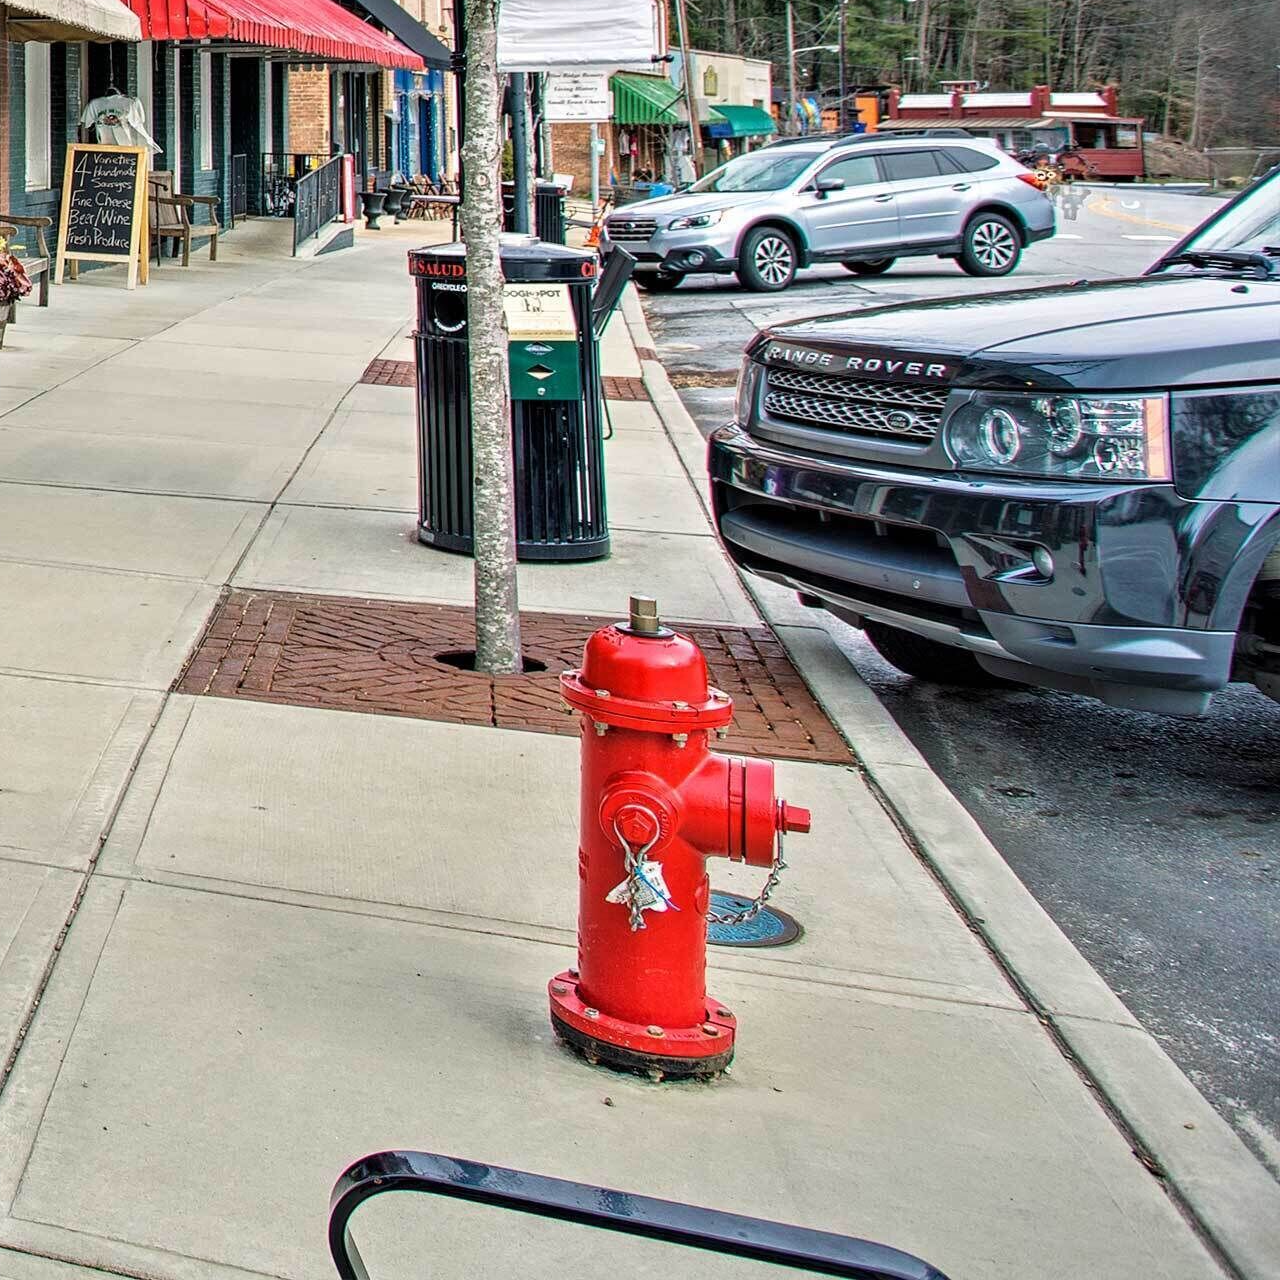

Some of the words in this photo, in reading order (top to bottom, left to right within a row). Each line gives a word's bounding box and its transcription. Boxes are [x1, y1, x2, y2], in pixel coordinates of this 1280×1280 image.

[75, 153, 91, 187] 4
[94, 154, 136, 166] Varieties
[93, 166, 135, 177] Handmade
[72, 190, 93, 207] Fine
[95, 192, 132, 209] Cheese
[69, 207, 130, 226] Beer/Wine
[67, 226, 91, 246] Fresh
[94, 228, 130, 248] Produce
[417, 259, 466, 277] SALUD
[768, 346, 834, 367] RANGE
[846, 356, 947, 378] ROVER
